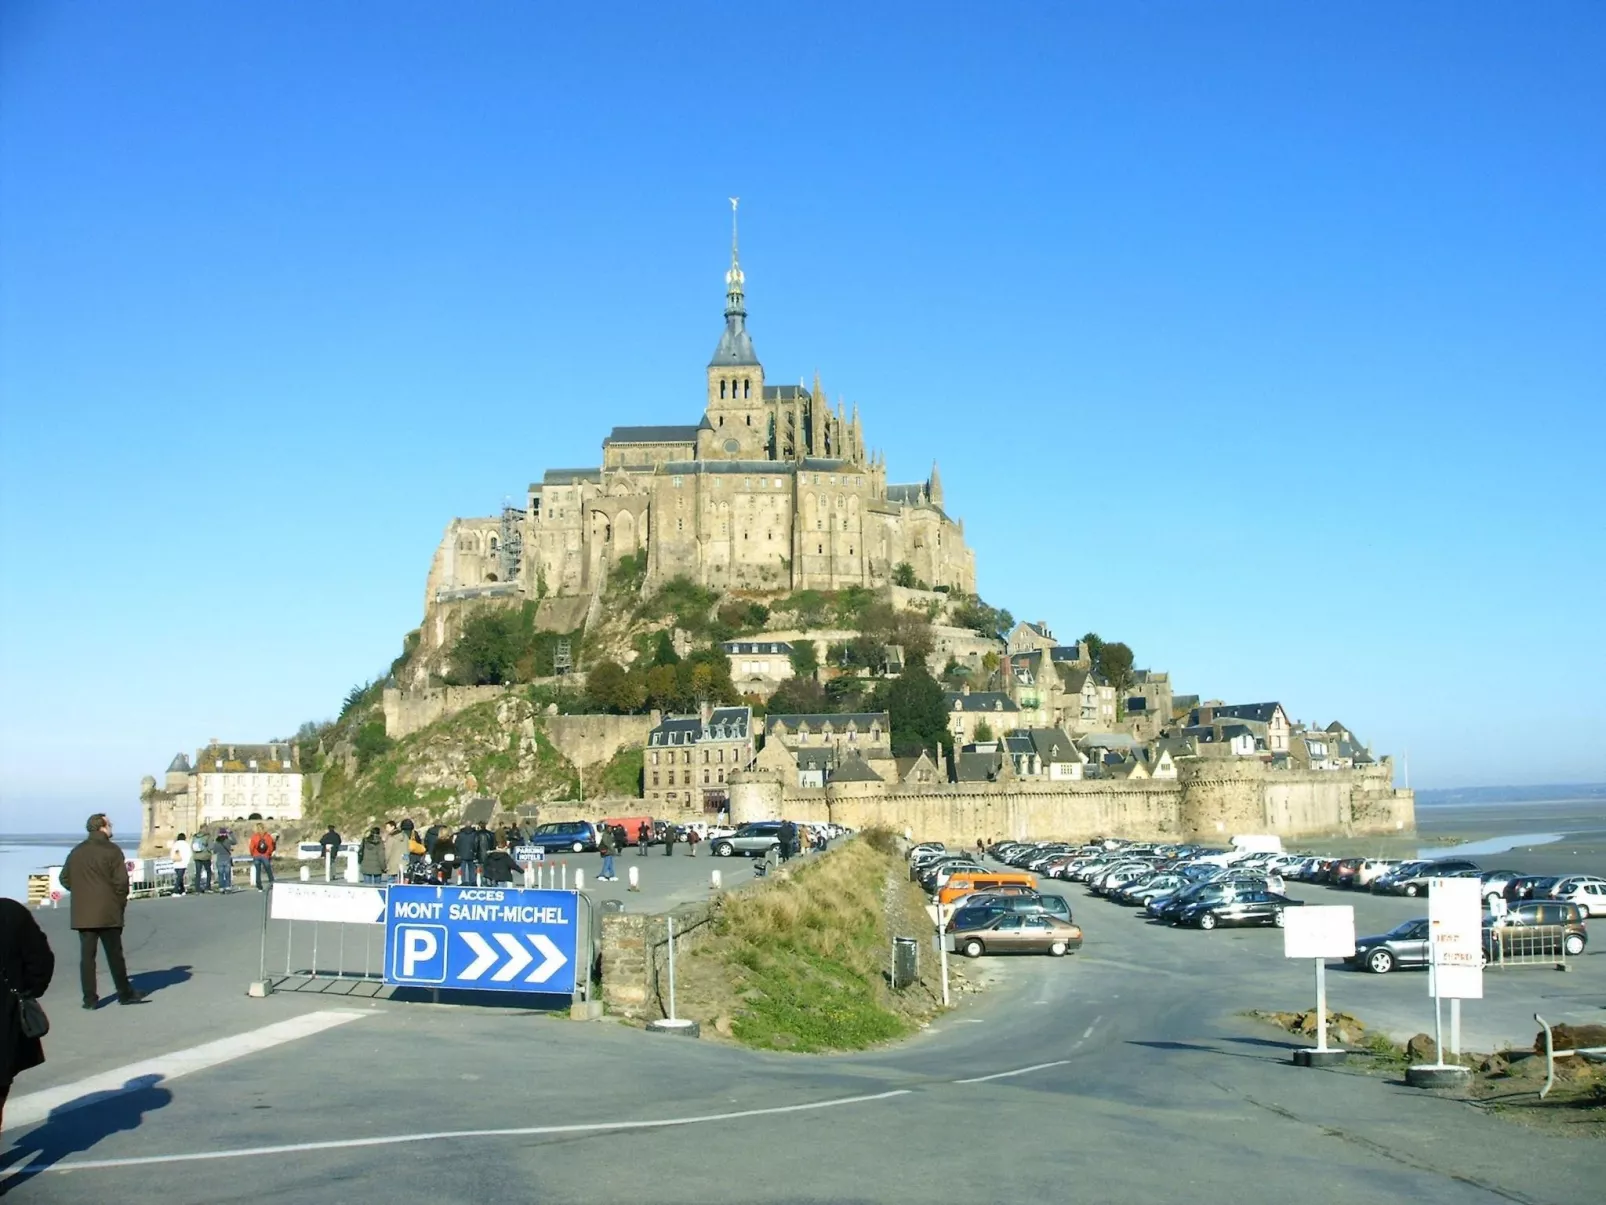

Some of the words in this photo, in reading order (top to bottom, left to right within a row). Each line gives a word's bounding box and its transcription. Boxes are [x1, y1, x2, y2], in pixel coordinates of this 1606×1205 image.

[458, 889, 504, 901] ACCES
[395, 902, 443, 919] MONT
[449, 904, 568, 924] SAINT-MICHEL
[403, 929, 437, 976] P
